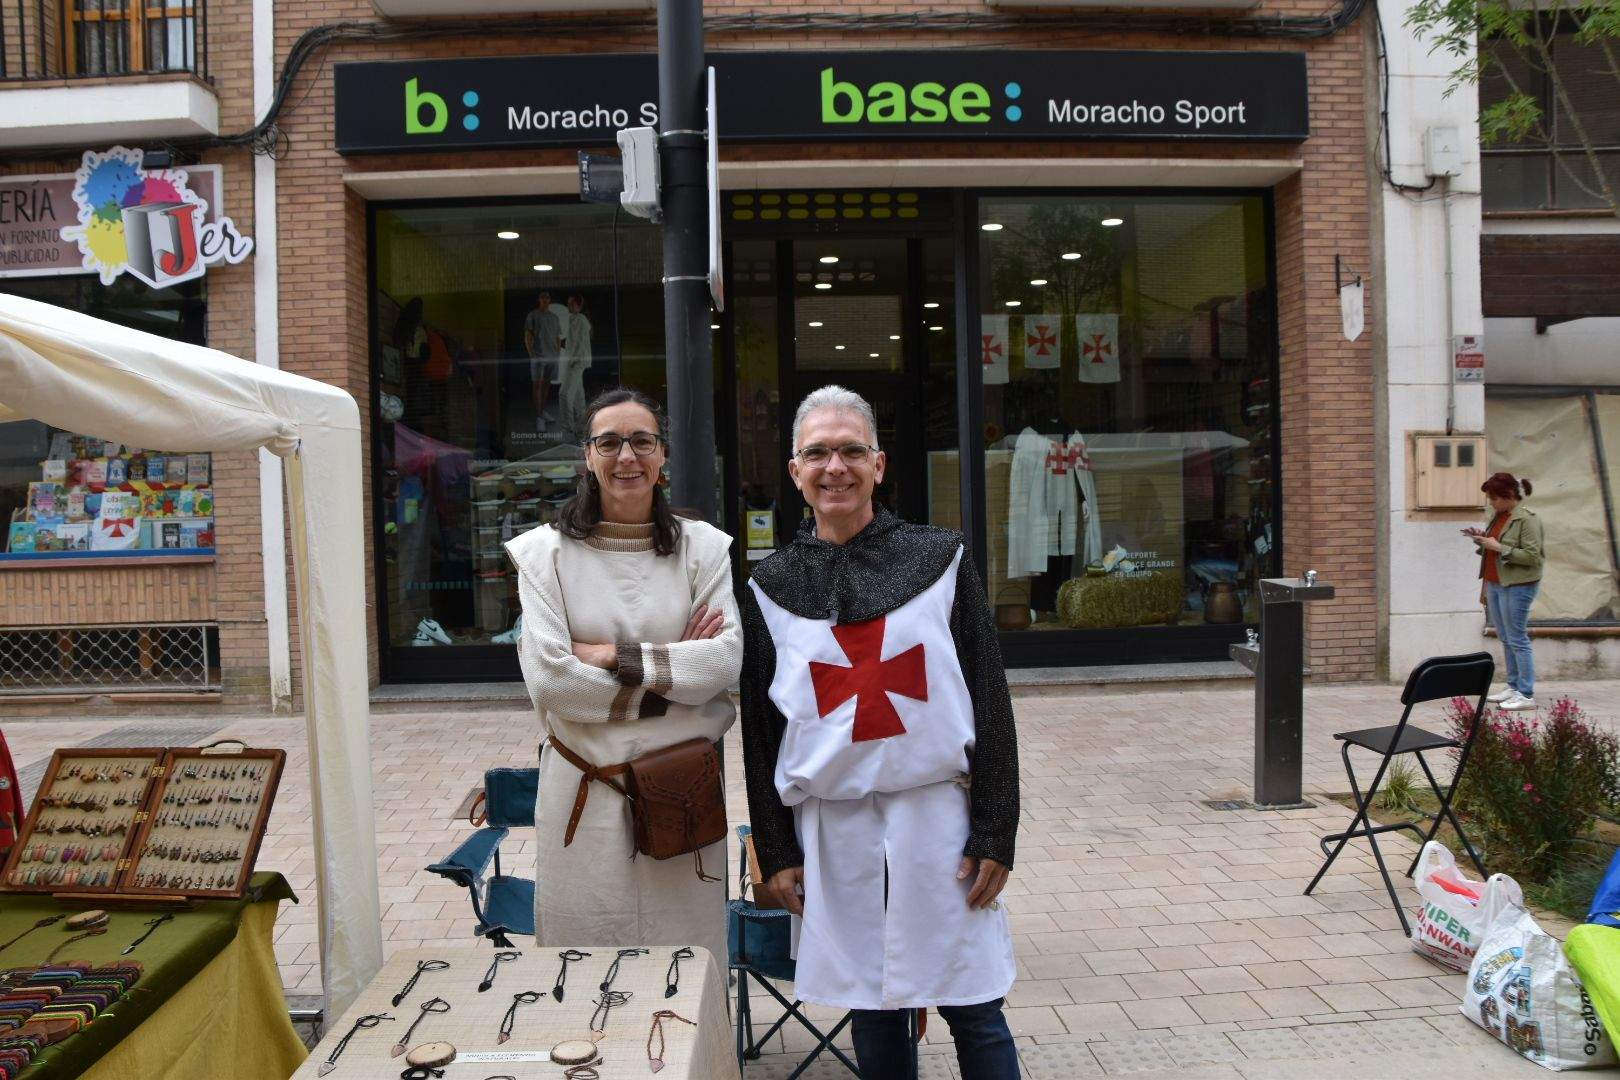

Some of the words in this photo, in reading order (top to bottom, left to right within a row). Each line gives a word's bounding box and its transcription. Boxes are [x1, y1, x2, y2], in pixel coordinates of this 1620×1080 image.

[508, 104, 628, 130] Moracho
[1048, 100, 1165, 124] Moracho
[1174, 100, 1247, 128] Sport
[11, 229, 60, 244] FORMATO
